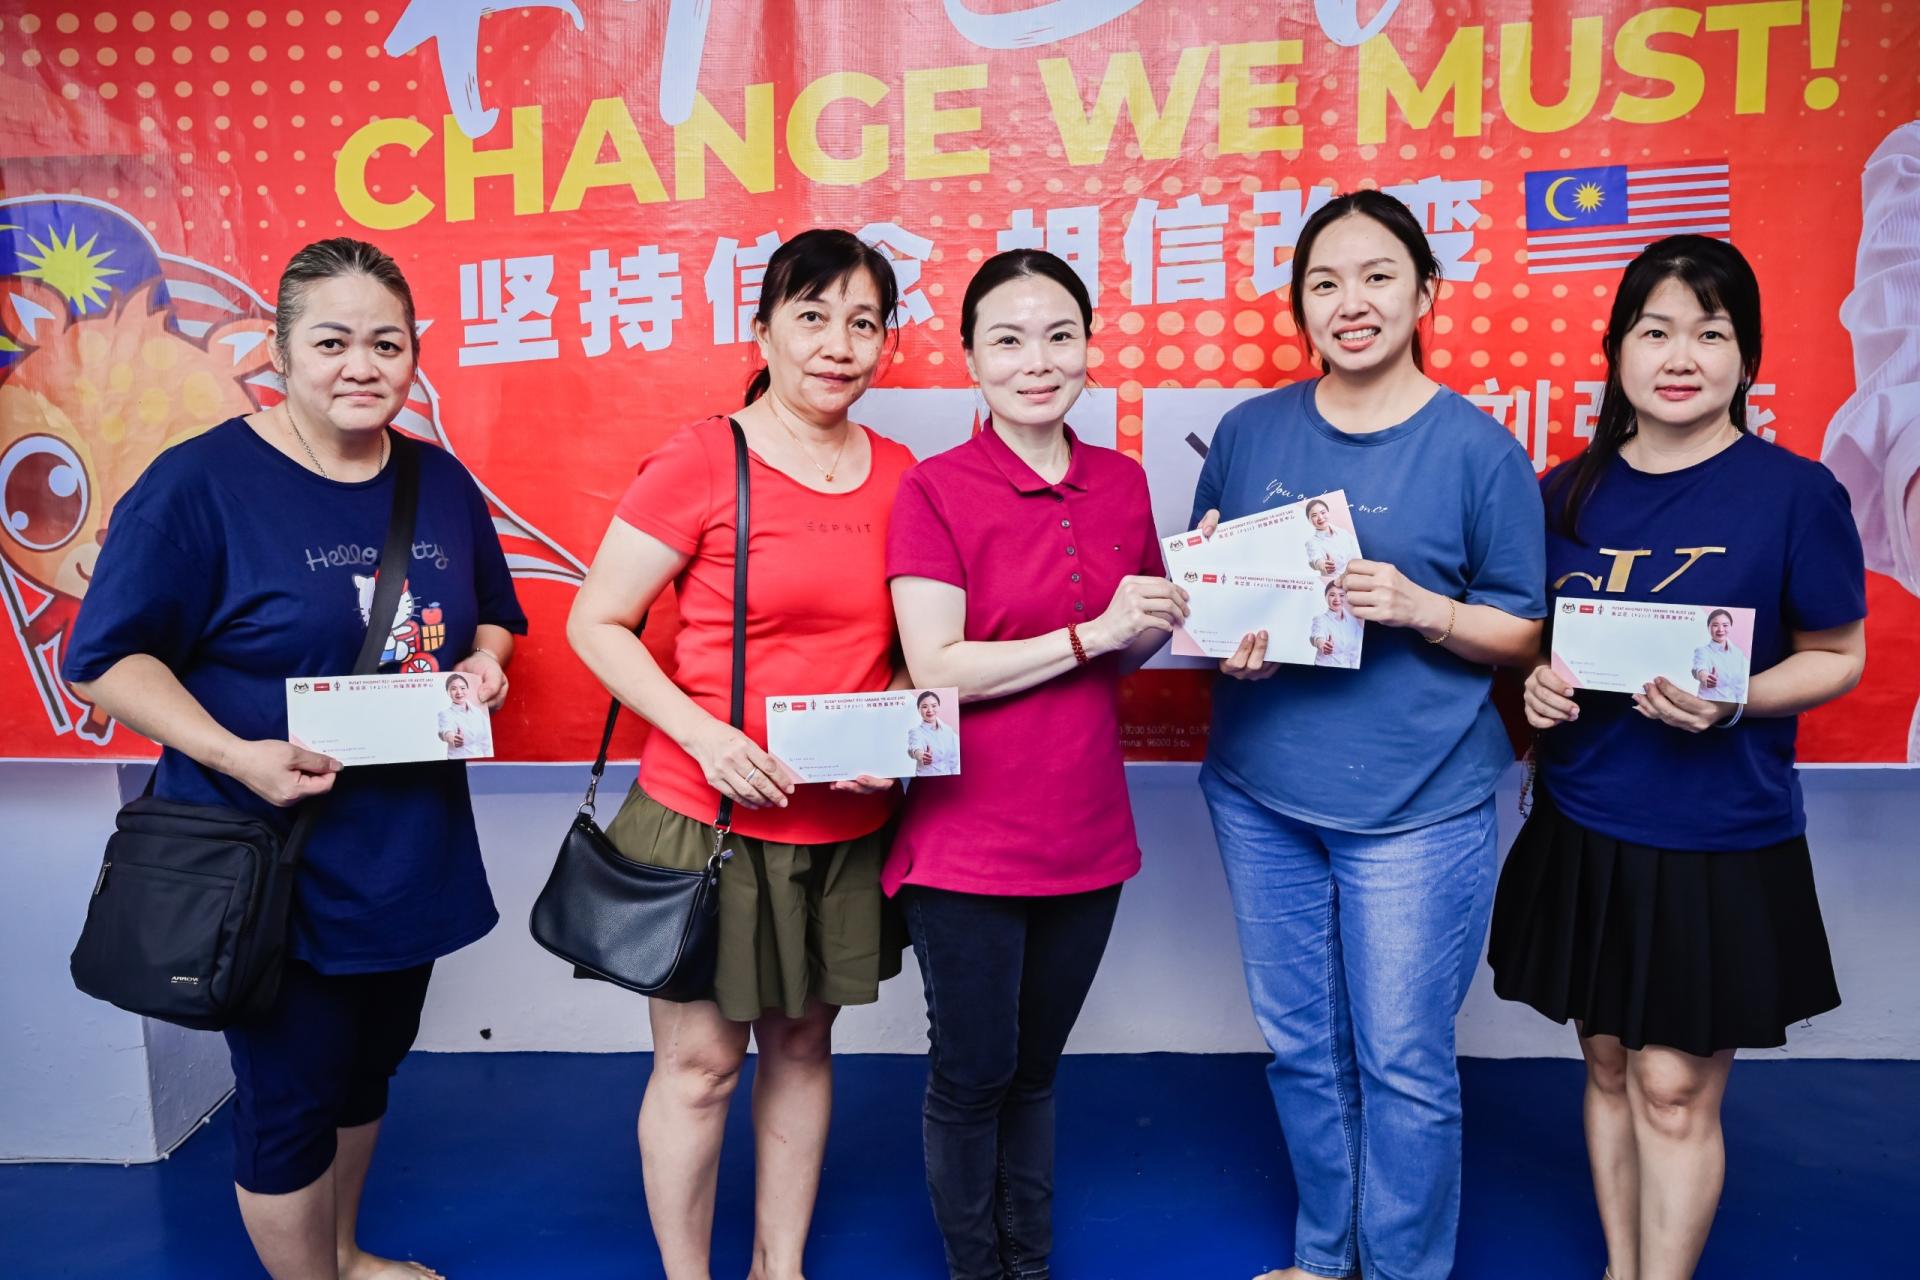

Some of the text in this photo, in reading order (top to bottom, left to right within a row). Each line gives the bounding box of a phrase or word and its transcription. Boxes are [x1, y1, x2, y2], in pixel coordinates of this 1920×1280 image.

[335, 63, 990, 231] CHANGE
[1037, 40, 1304, 166] WE
[1356, 0, 1844, 145] MUST!
[1262, 479, 1294, 504] You
[305, 540, 449, 572] Hello tty
